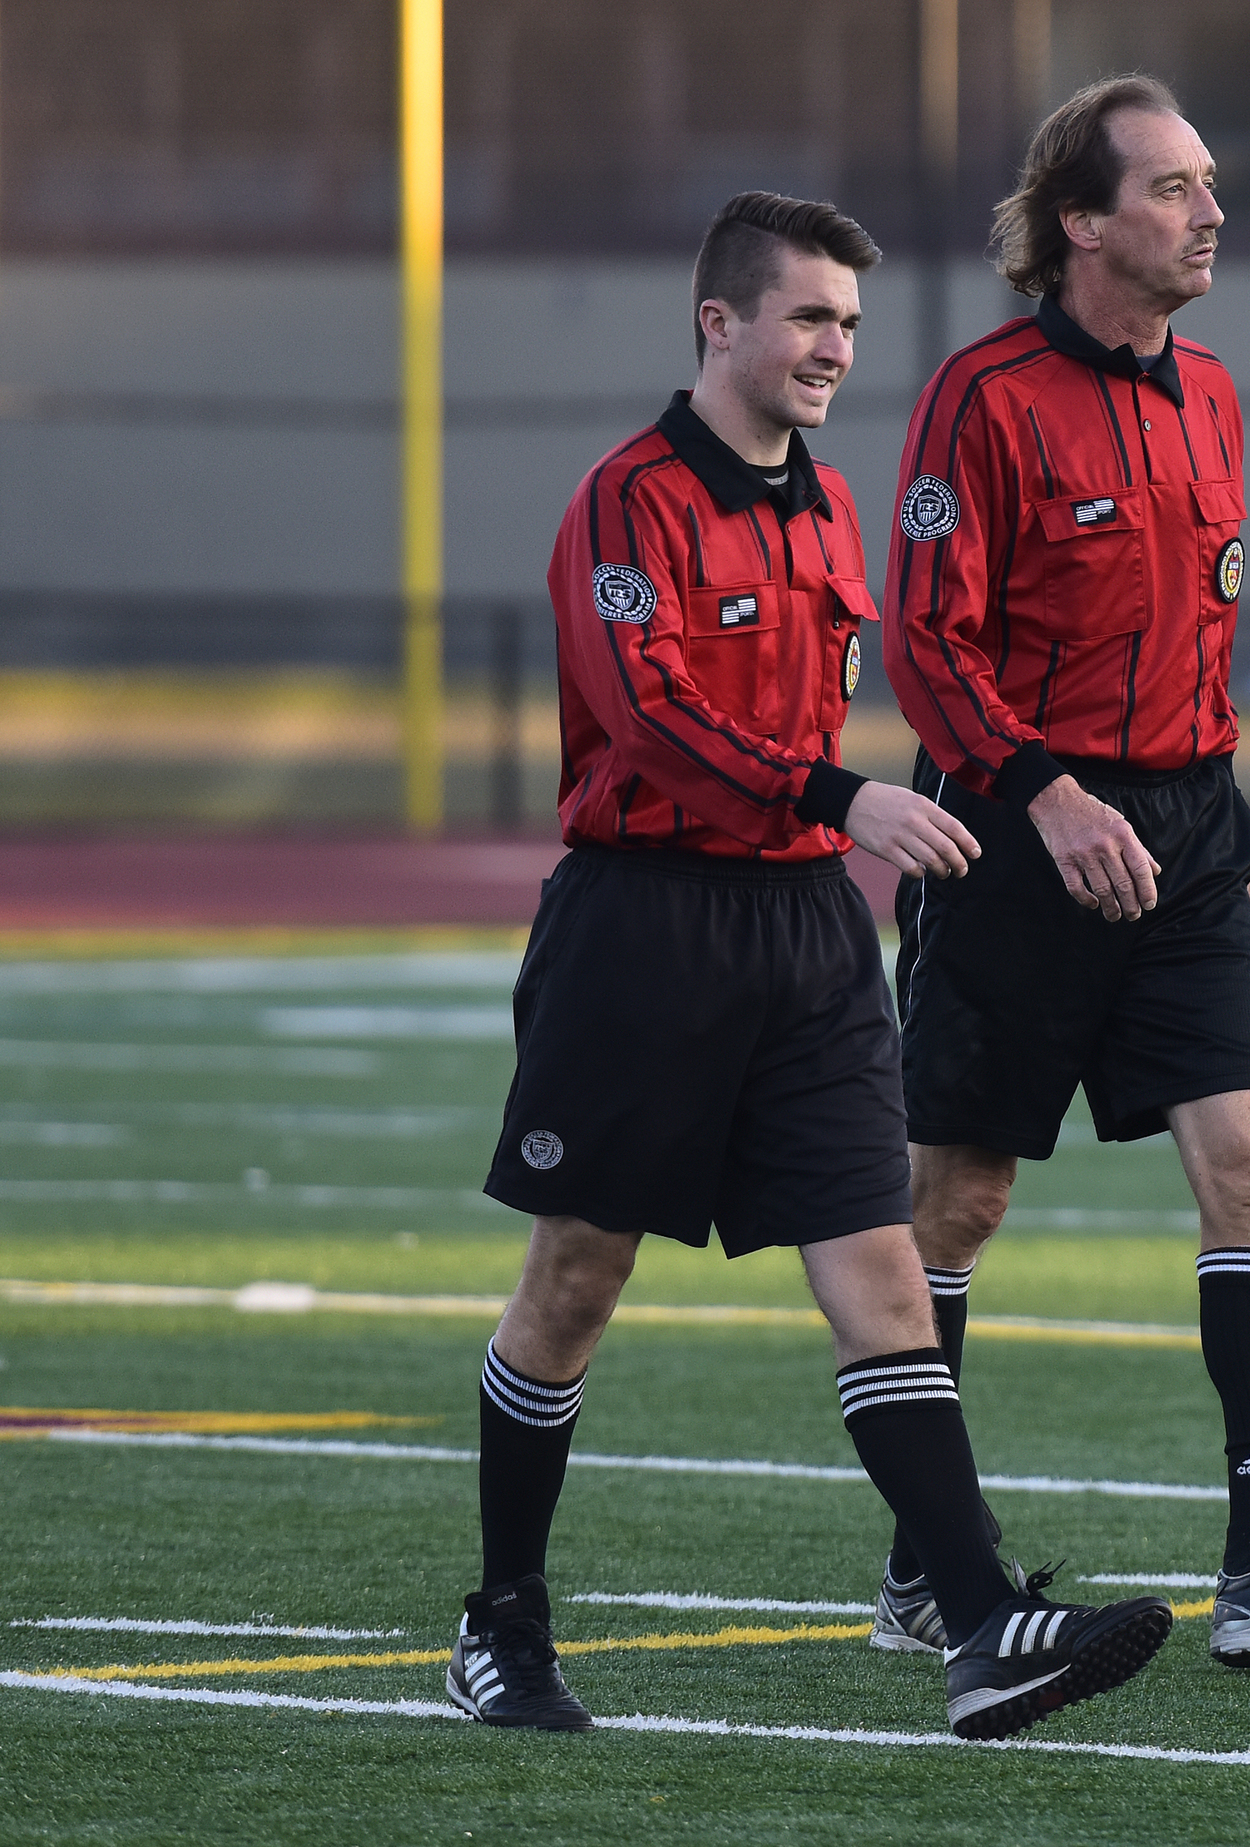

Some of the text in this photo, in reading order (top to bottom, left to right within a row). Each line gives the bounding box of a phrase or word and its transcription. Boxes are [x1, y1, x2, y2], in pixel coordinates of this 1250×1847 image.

[931, 480, 957, 518] FEDERATION
[616, 568, 652, 597] FEDERATION
[491, 1591, 517, 1607] adidas
